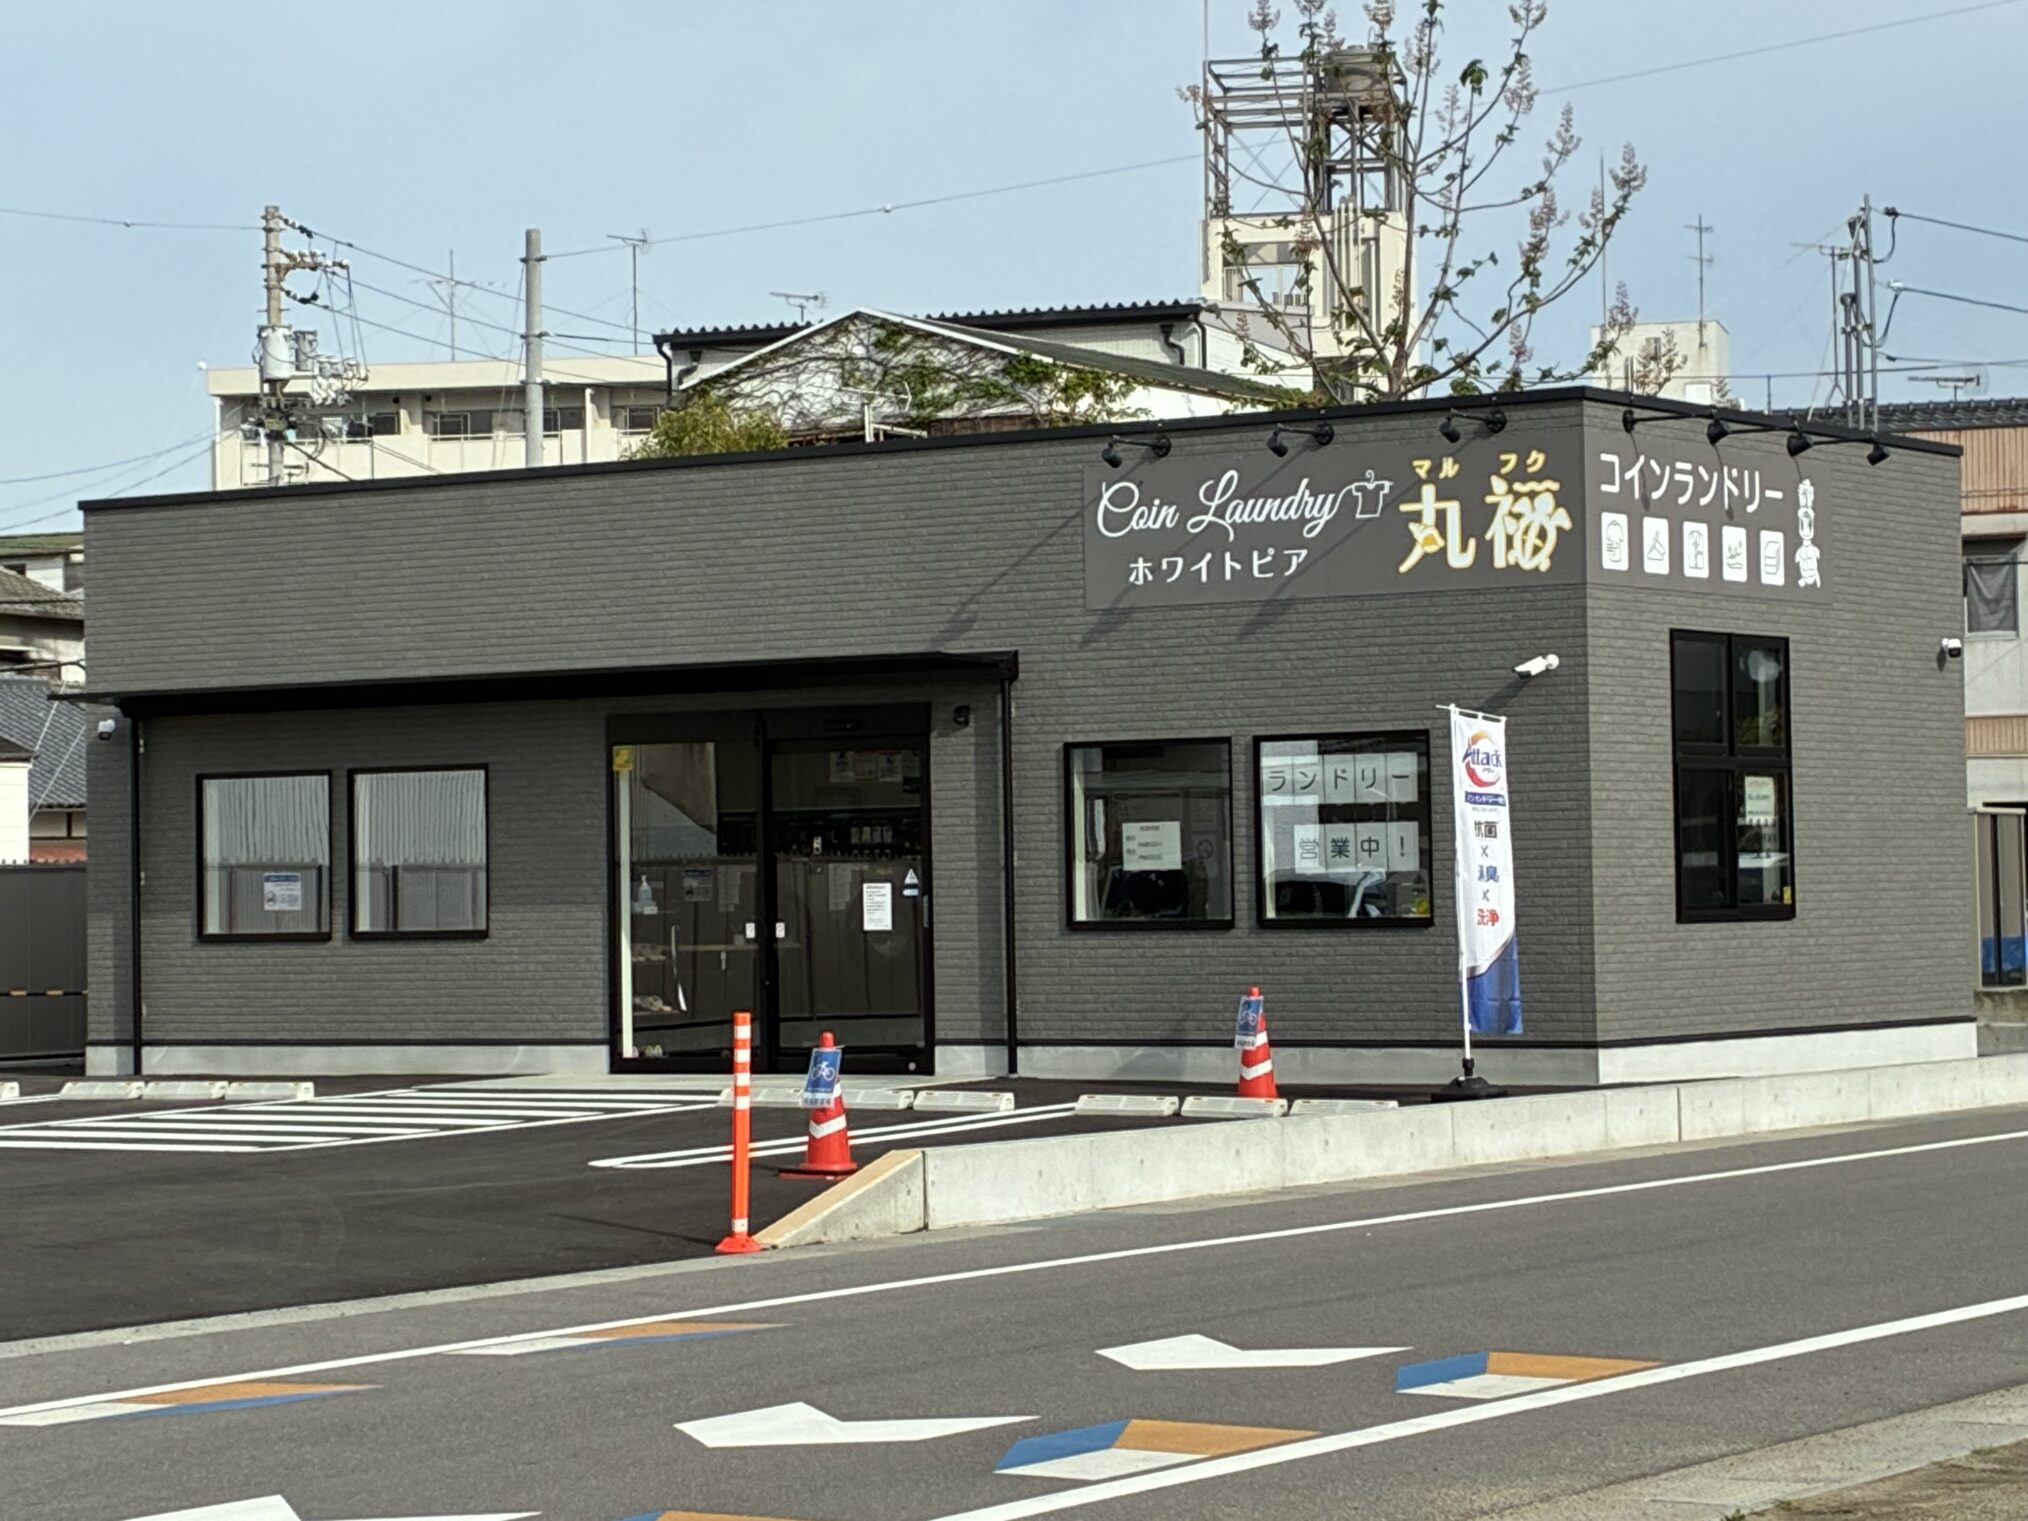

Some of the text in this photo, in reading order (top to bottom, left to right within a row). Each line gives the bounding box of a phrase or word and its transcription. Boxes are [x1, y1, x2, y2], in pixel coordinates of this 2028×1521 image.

[1412, 450, 1546, 479] マル フク
[1600, 453, 1783, 513] コインランドリー
[1097, 468, 1341, 543] Coin Laundry
[1128, 547, 1309, 586] ホワイトピア
[1266, 767, 1411, 792] ランドリー
